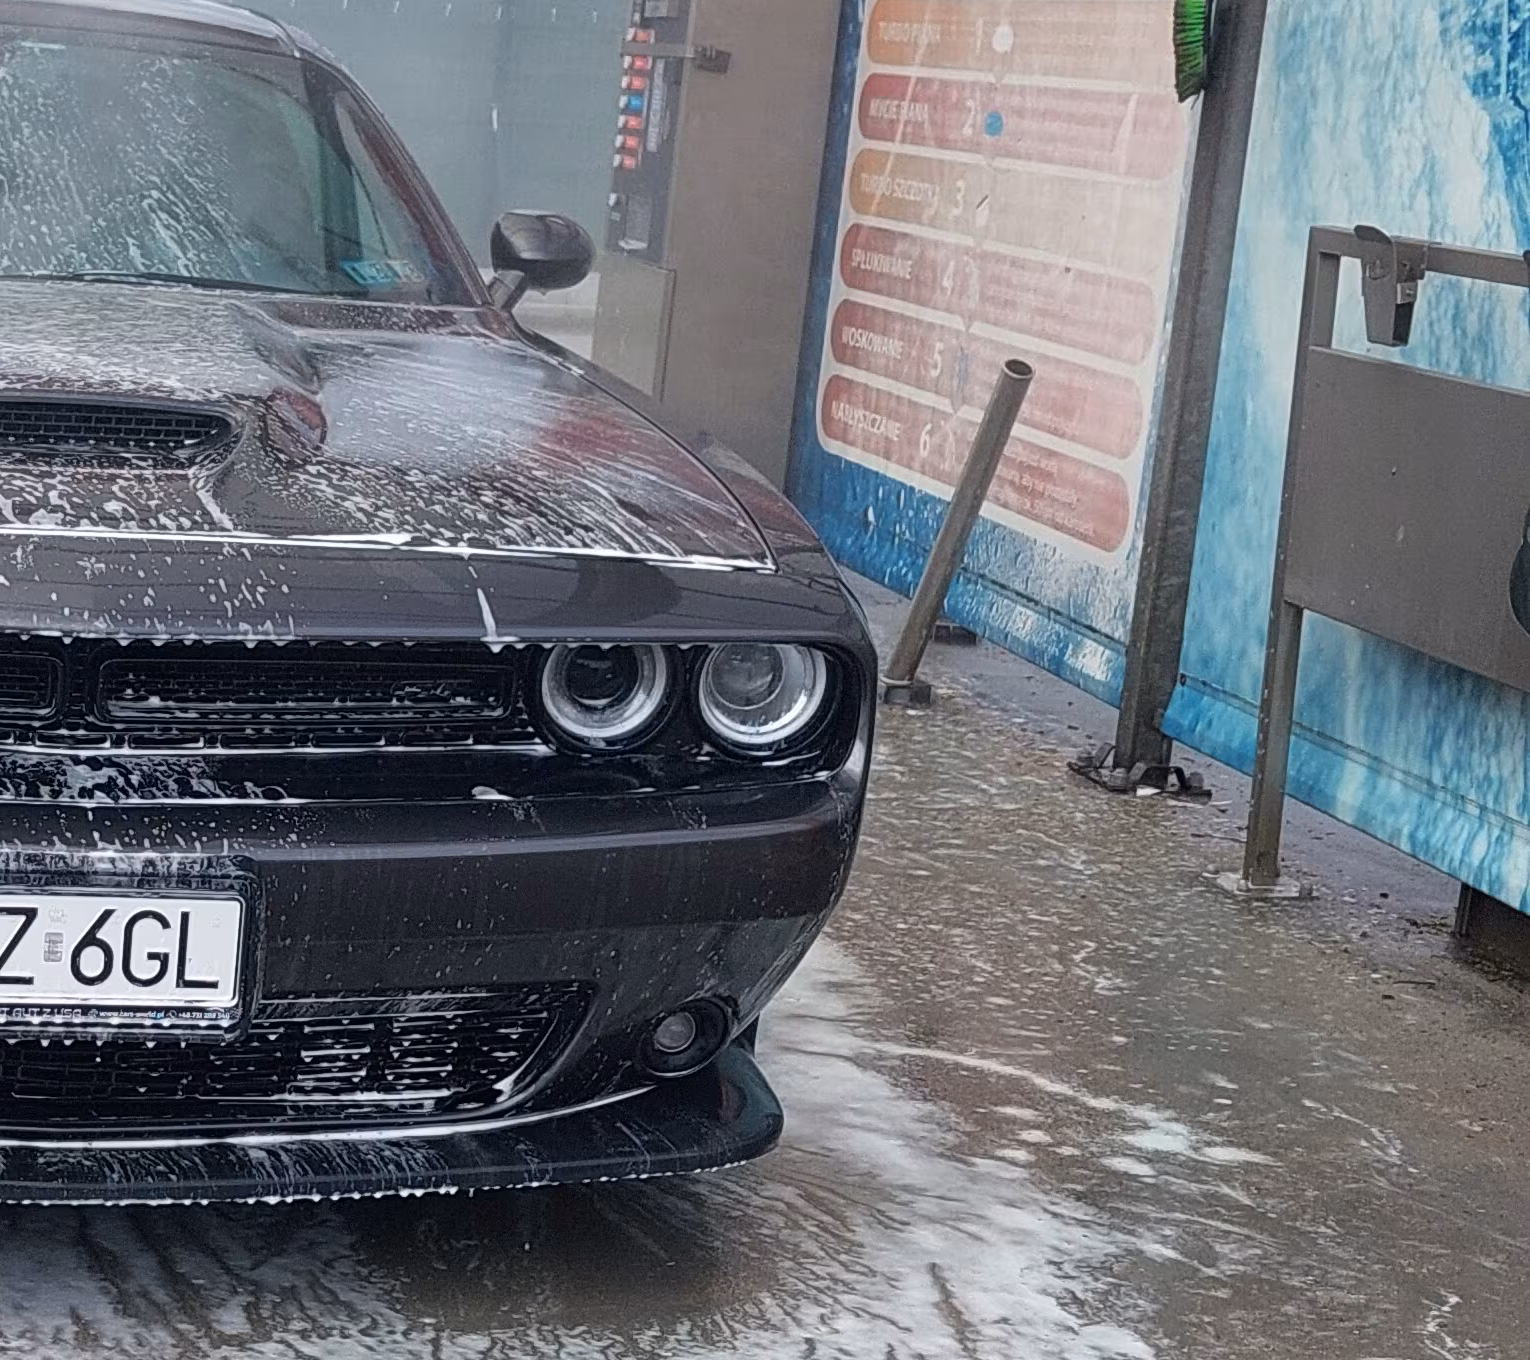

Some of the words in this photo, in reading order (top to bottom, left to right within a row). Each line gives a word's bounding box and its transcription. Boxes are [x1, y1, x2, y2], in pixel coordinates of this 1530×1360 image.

[930, 342, 944, 378] 5
[919, 423, 934, 460] 6
[70, 908, 220, 989] 6GL
